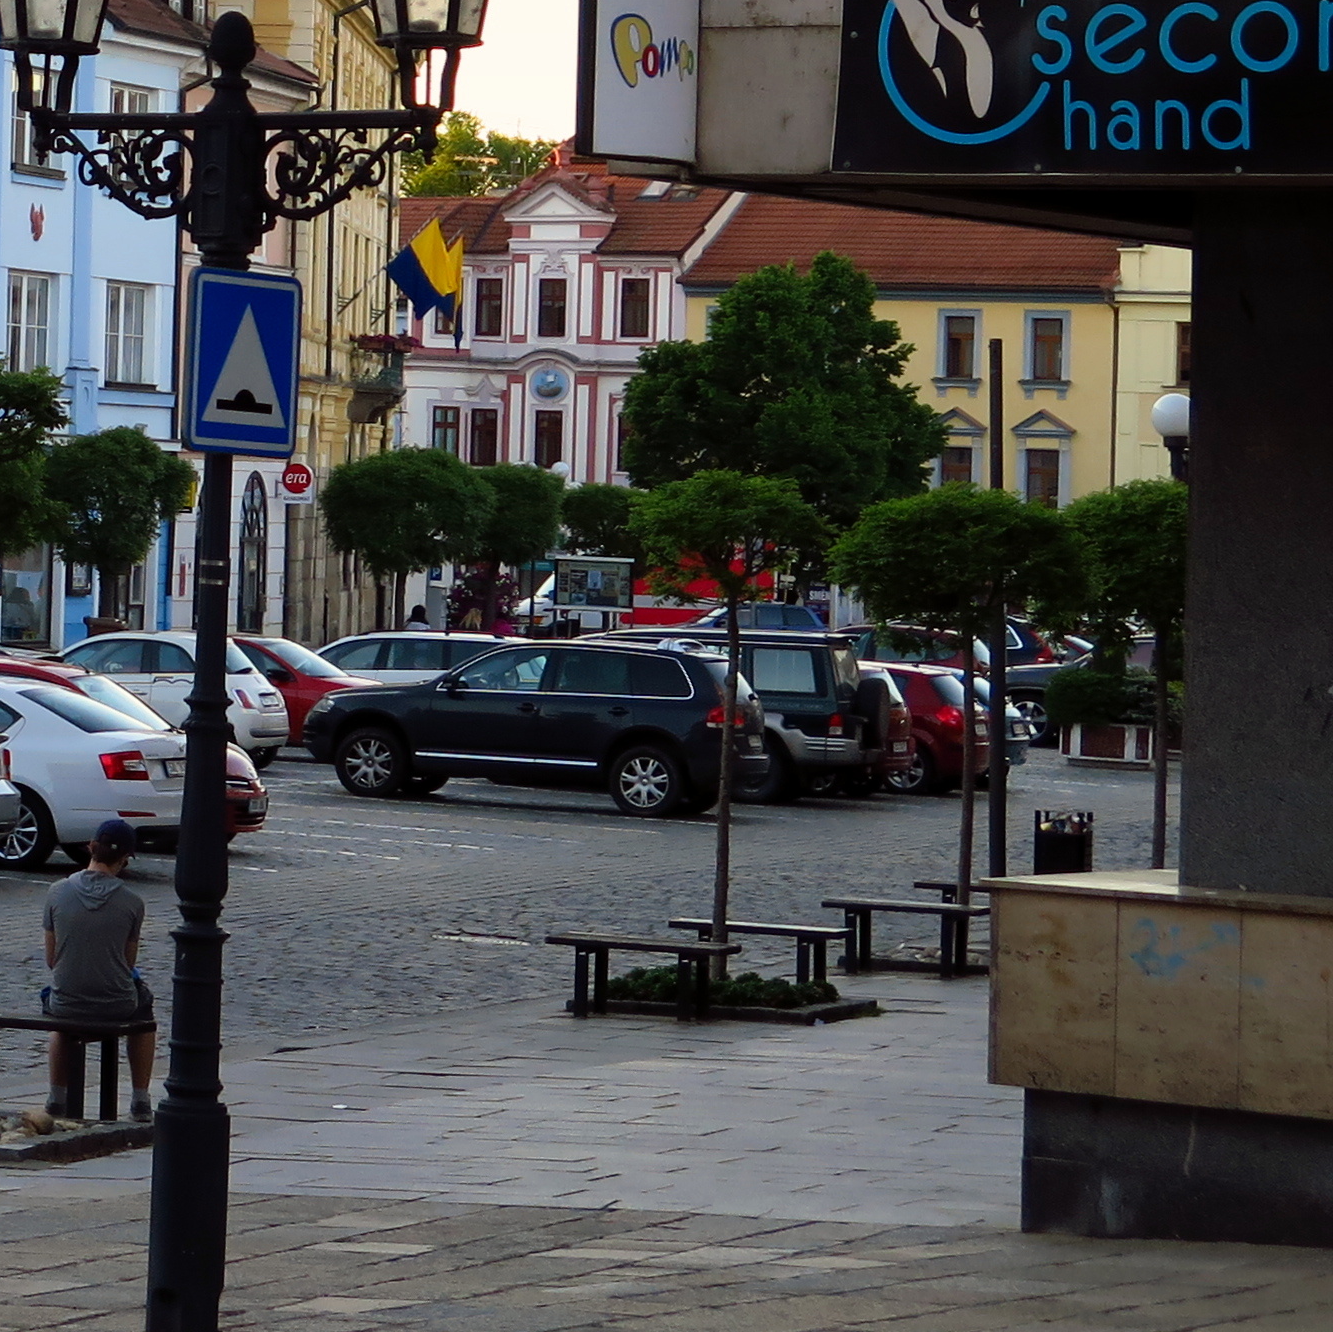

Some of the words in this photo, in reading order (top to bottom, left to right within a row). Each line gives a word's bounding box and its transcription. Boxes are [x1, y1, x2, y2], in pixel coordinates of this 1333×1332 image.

[610, 13, 695, 89] Pompo
[1063, 77, 1251, 151] hand
[285, 472, 307, 484] era
